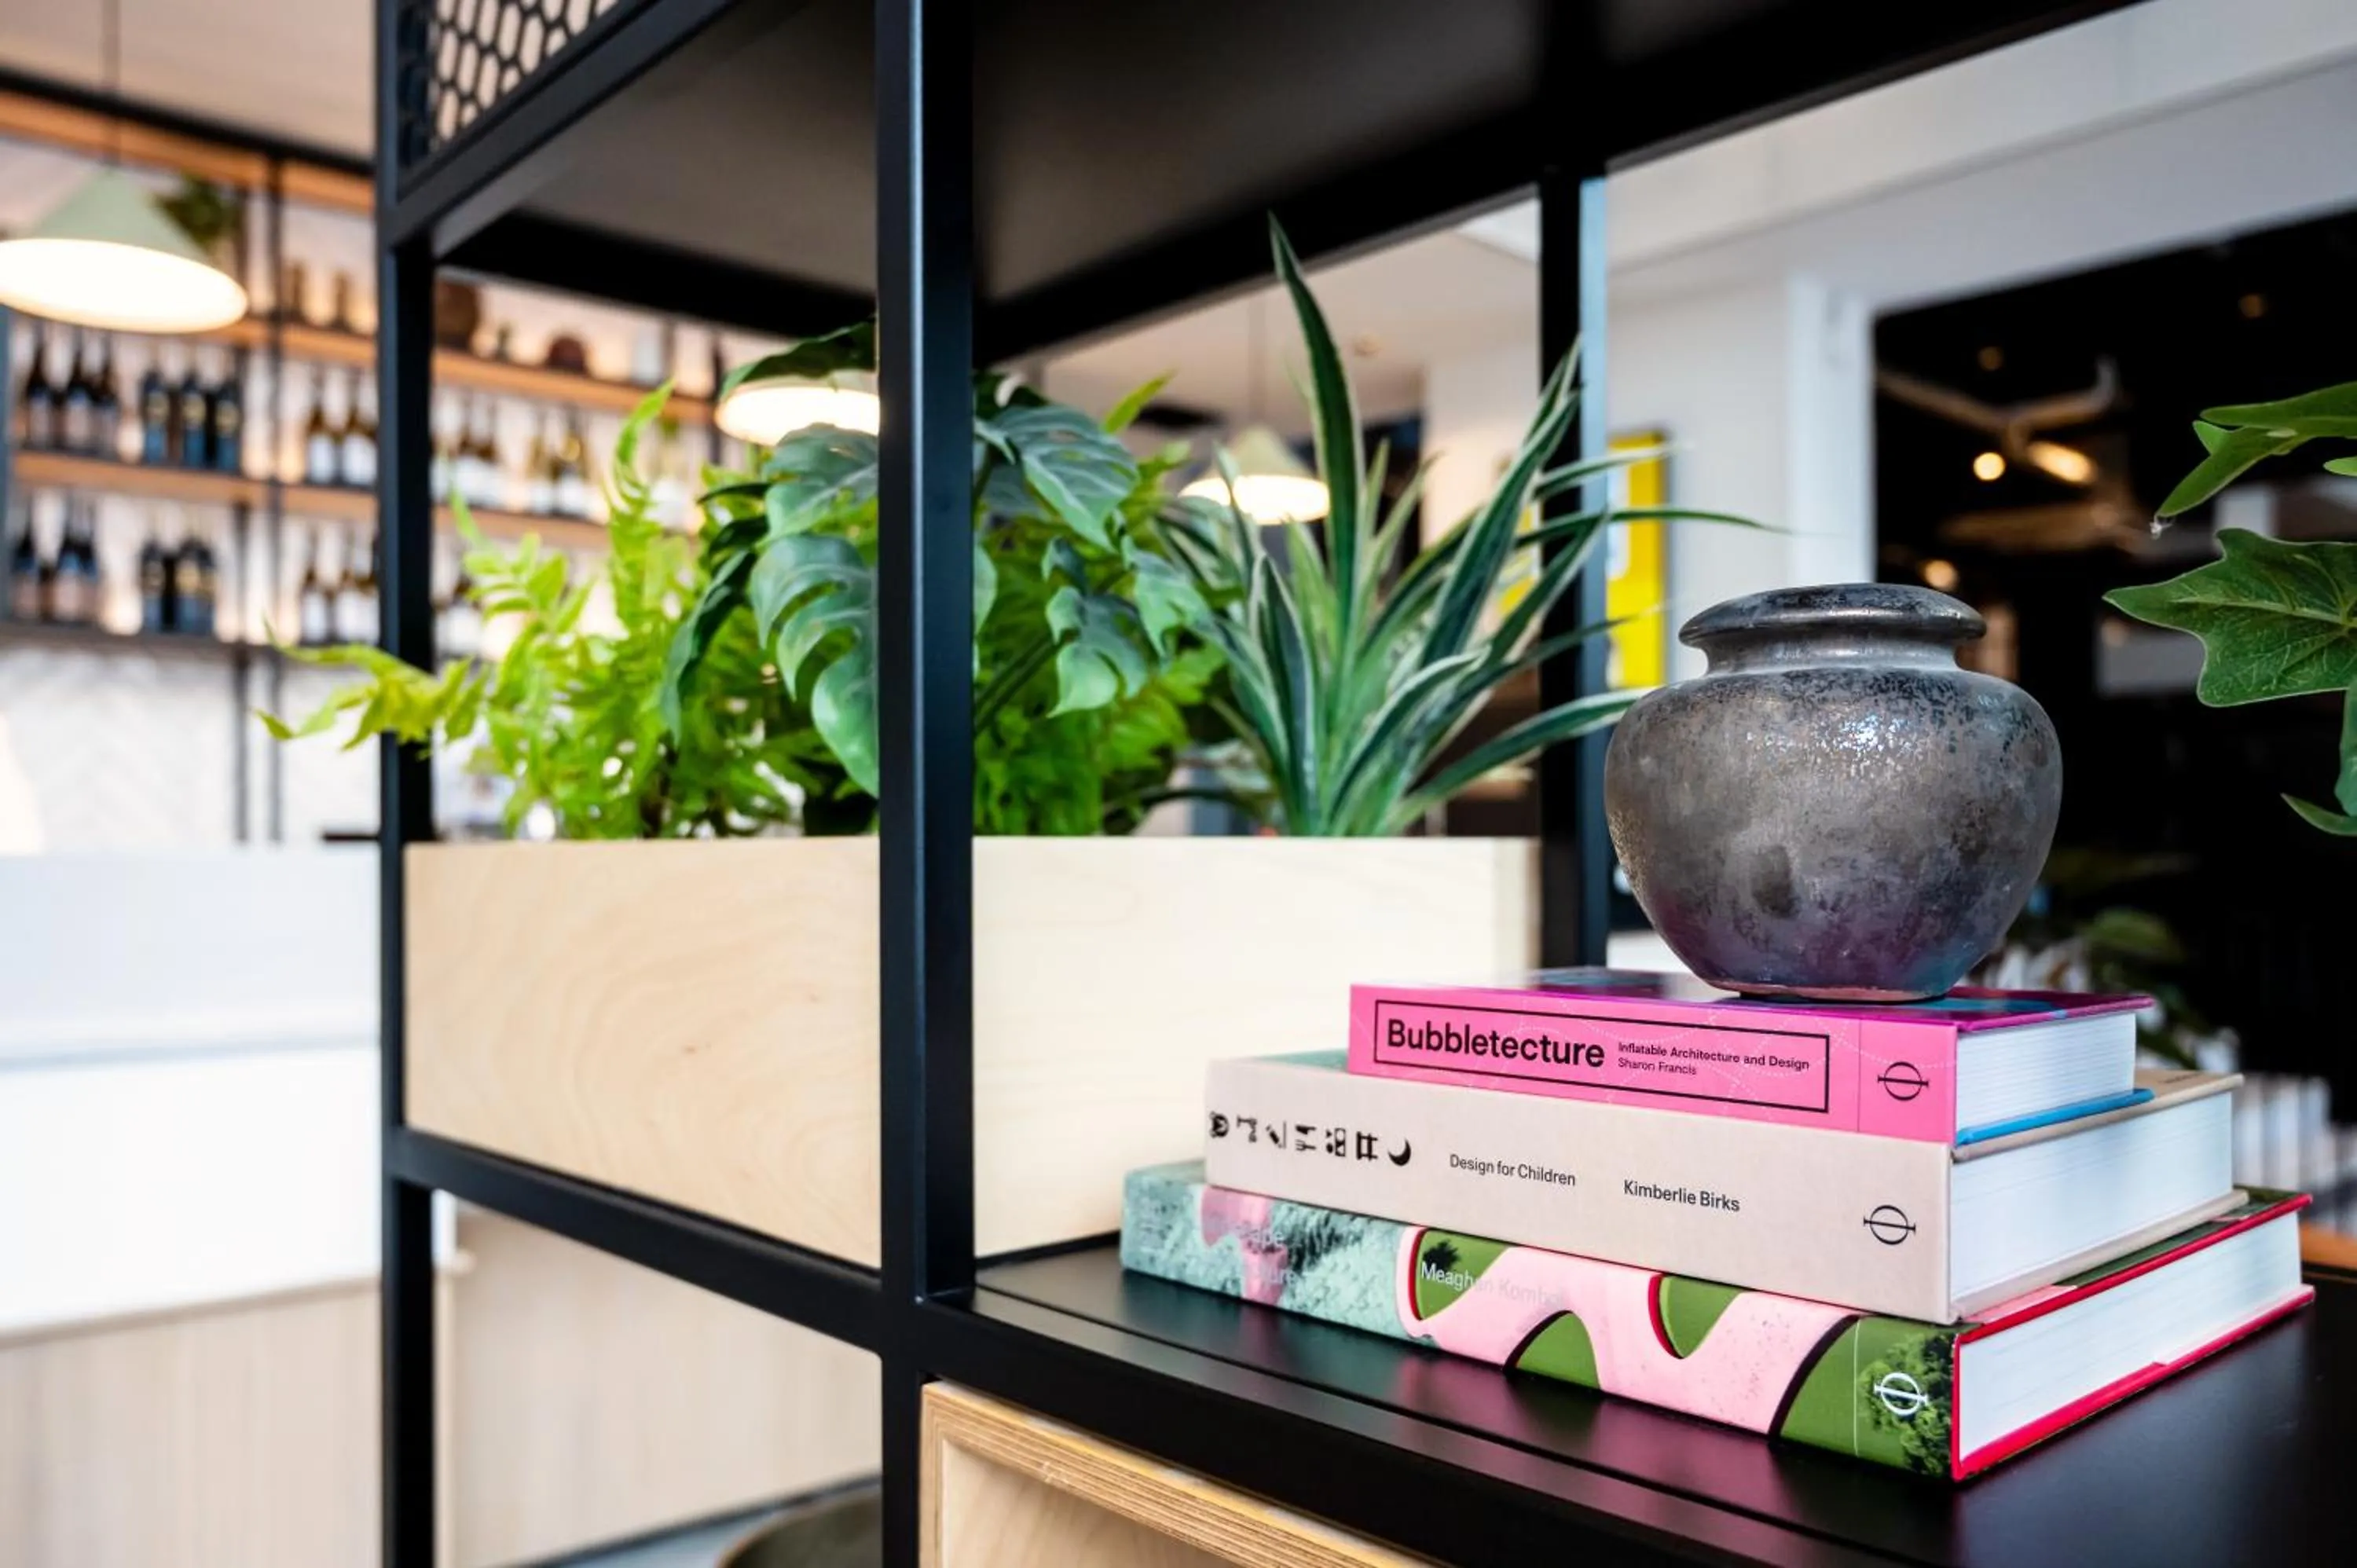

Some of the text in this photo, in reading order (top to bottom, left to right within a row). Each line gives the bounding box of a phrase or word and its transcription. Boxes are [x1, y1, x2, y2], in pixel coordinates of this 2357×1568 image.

[1387, 1019, 1605, 1068] Bubbletecture
[1618, 1042, 1810, 1072] Inflatable Architecture and Design
[1618, 1057, 1697, 1075] Sharon Francis
[1450, 1153, 1576, 1186] Design for Children
[1624, 1179, 1740, 1212] Kimberlie Birks
